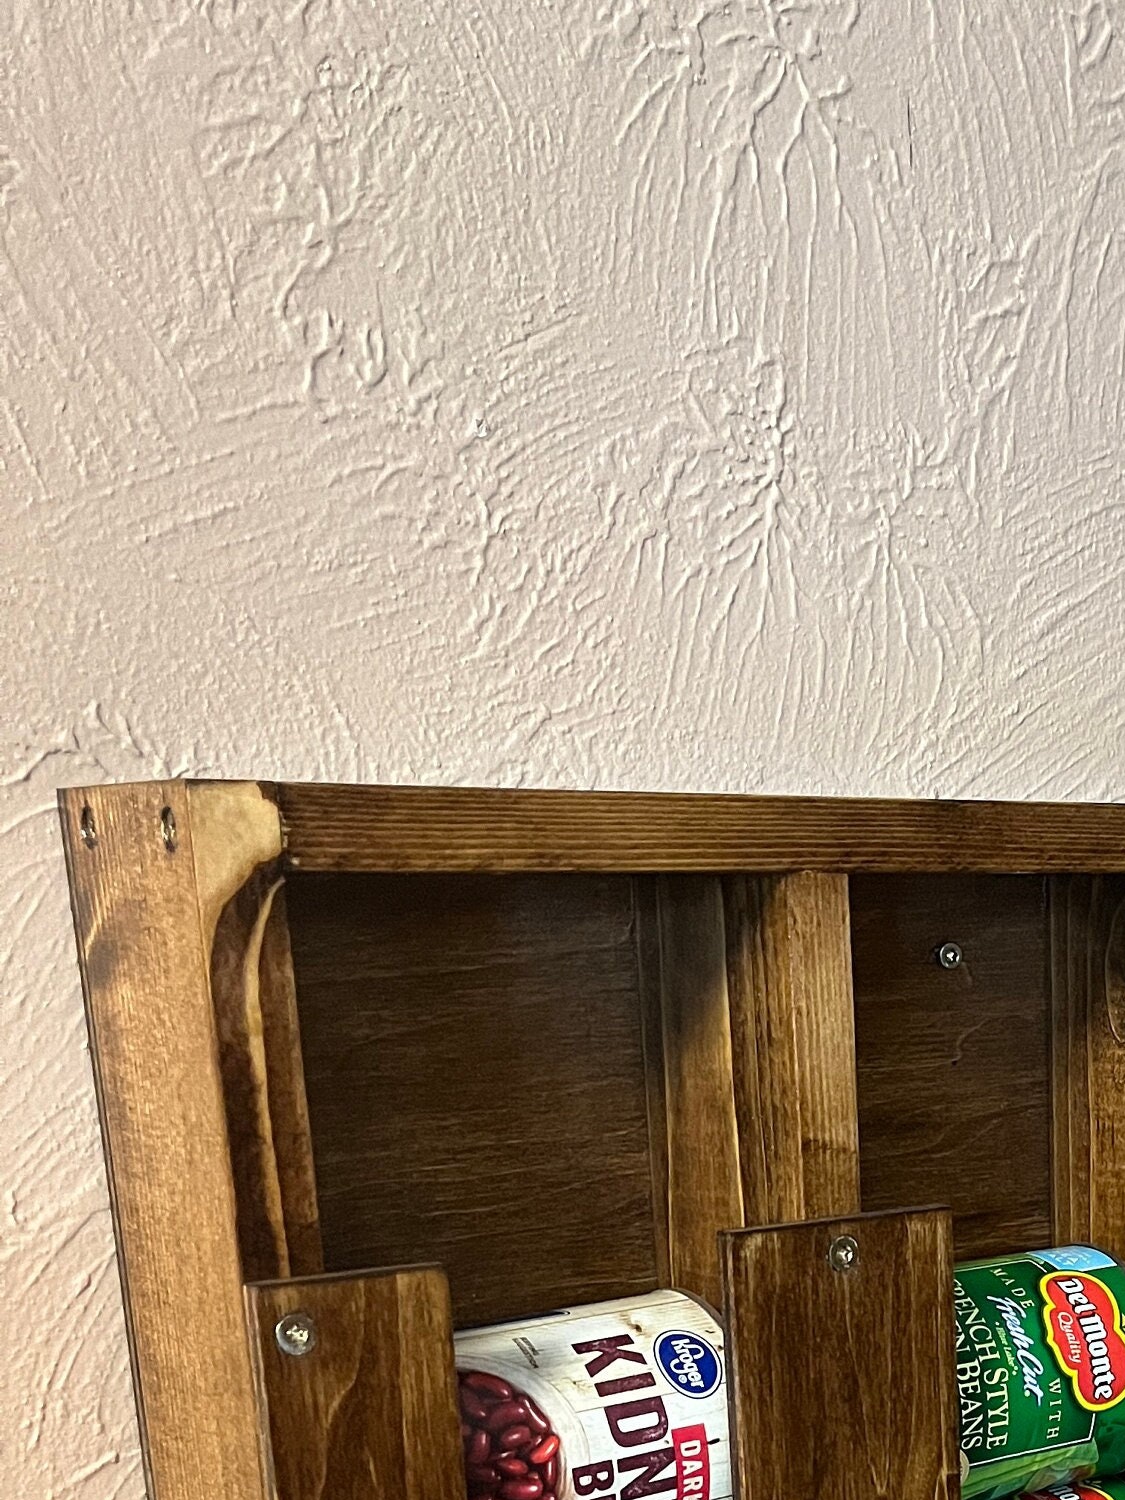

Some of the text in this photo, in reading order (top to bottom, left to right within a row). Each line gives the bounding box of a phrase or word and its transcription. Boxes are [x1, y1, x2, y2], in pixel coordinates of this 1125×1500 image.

[990, 1268, 1035, 1309] MADE
[671, 1337, 705, 1389] Kroger
[987, 1295, 1044, 1408] Fresh Cut
[1056, 1311, 1082, 1364] Quality
[1057, 1277, 1098, 1318] Del
[1081, 1314, 1116, 1400] Monte
[956, 1360, 983, 1450] BEANS
[984, 1367, 1009, 1450] STYLE
[1047, 1378, 1061, 1439] WITH
